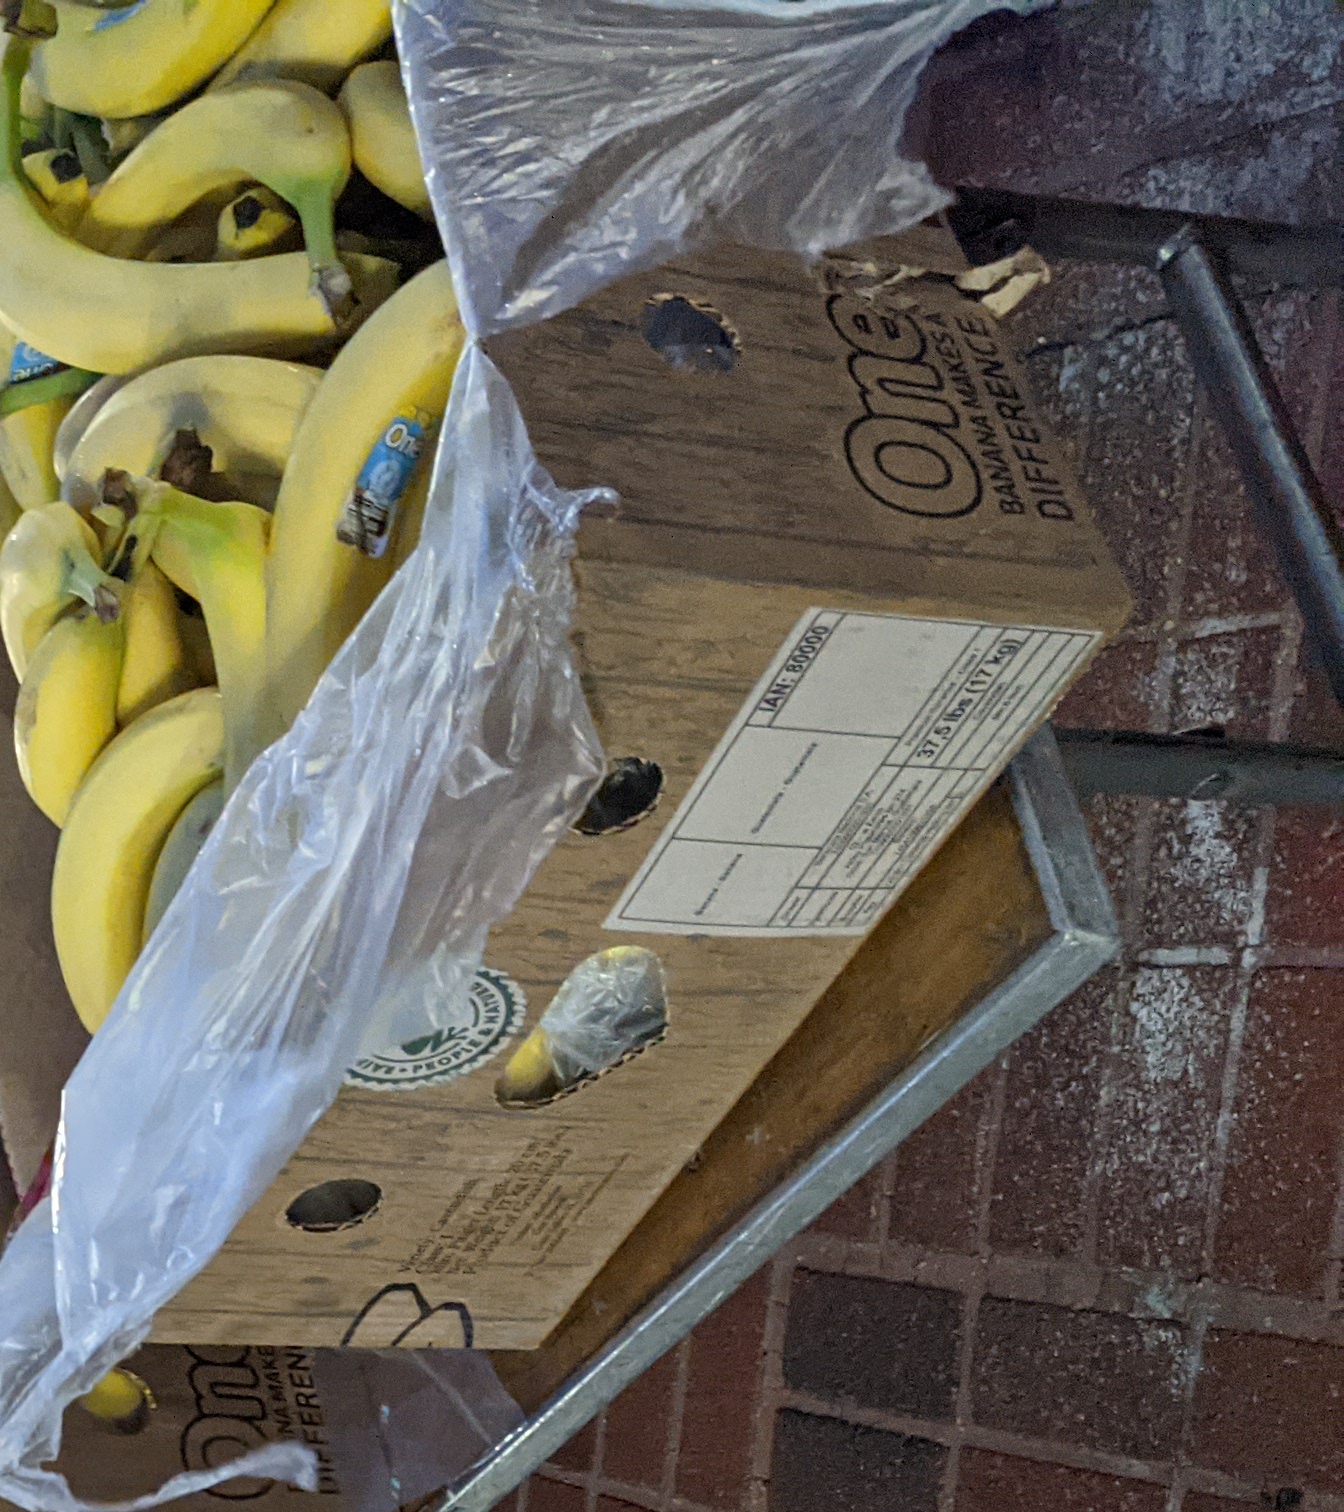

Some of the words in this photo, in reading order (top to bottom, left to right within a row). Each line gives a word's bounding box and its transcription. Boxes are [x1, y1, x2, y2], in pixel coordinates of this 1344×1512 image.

[924, 310, 945, 325] A
[824, 292, 984, 518] One
[932, 330, 985, 410] MAKES
[953, 316, 1075, 523] DIFFERENCE
[968, 416, 1027, 516] BANANA
[756, 677, 797, 713] IAN:
[782, 625, 832, 674] 80000
[915, 726, 957, 759] 37,5
[942, 698, 976, 723] lbs
[963, 668, 1001, 694] (17
[985, 638, 1024, 666] kg)
[466, 981, 501, 1026] NATURE
[478, 1026, 492, 1038] &
[411, 1038, 485, 1073] PEOPLE
